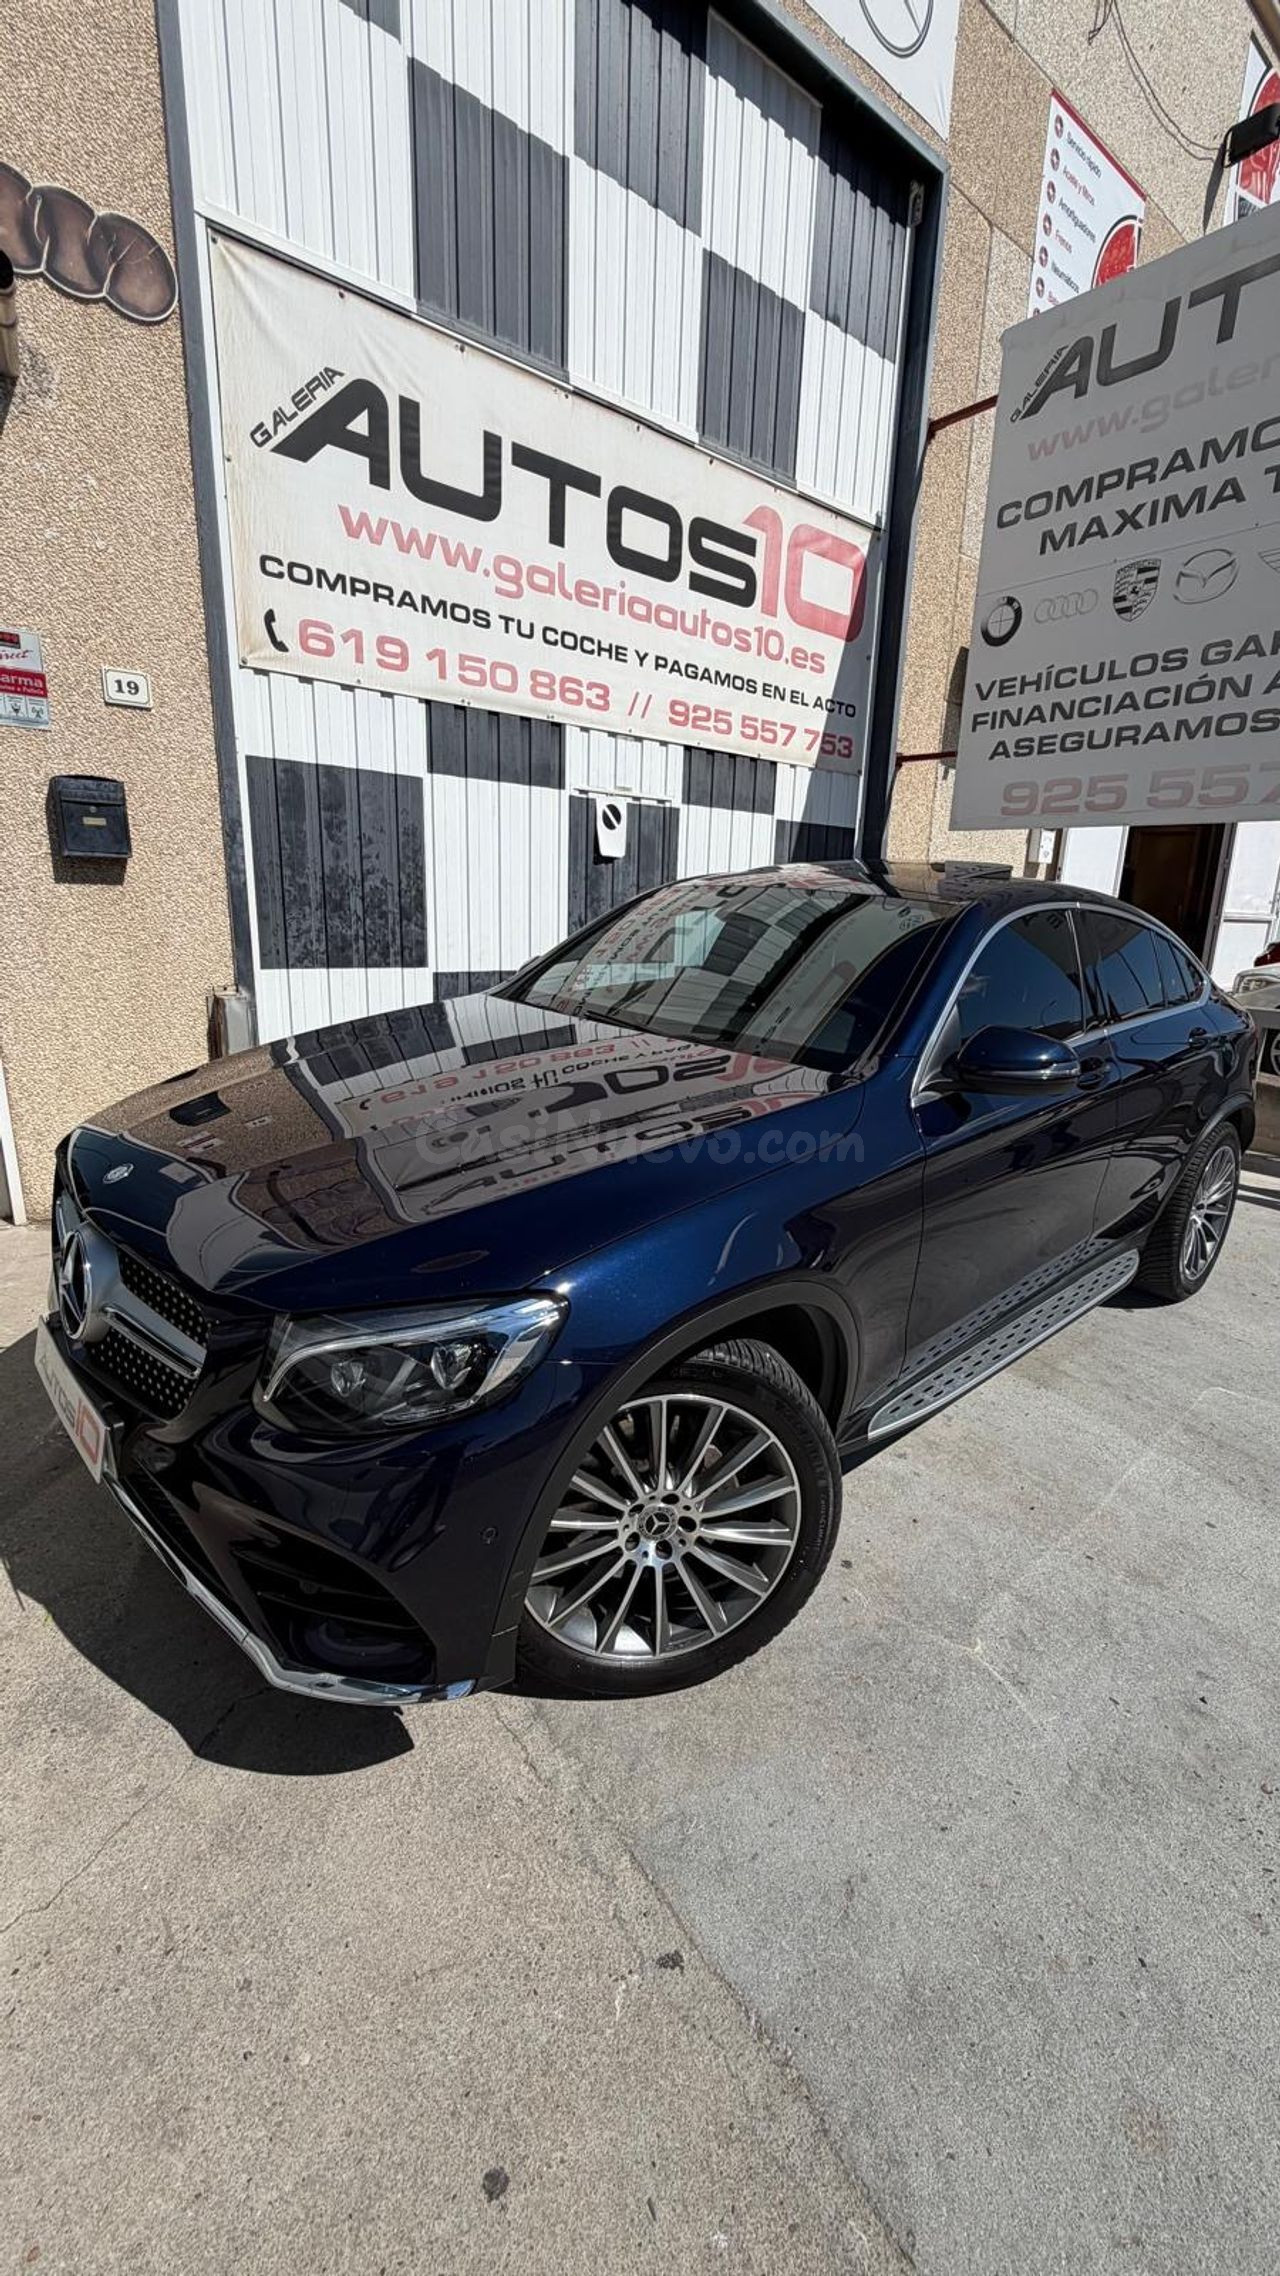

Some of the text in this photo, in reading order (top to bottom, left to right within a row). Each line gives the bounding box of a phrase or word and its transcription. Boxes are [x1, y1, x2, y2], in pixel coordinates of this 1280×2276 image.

[250, 366, 345, 448] GALERIA
[1010, 345, 1069, 423] GALERIA
[269, 378, 867, 642] AUTOS10
[1040, 477, 1247, 555] MAXIMA
[338, 504, 825, 674] www.galeriaautos10.es
[259, 554, 856, 718] COMPRAMOS TU COCHE Y PAGAMOS EN EL ACTO
[975, 648, 1189, 701] VEHÍCULOS
[114, 679, 140, 696] 19
[298, 618, 409, 672] 619
[426, 648, 518, 693] 150
[529, 668, 611, 712] 863
[668, 699, 732, 735] 925
[740, 715, 796, 747] 557
[804, 728, 853, 758] 753
[971, 673, 1253, 733] FINANCIACIÓN
[1001, 773, 1129, 817] 925
